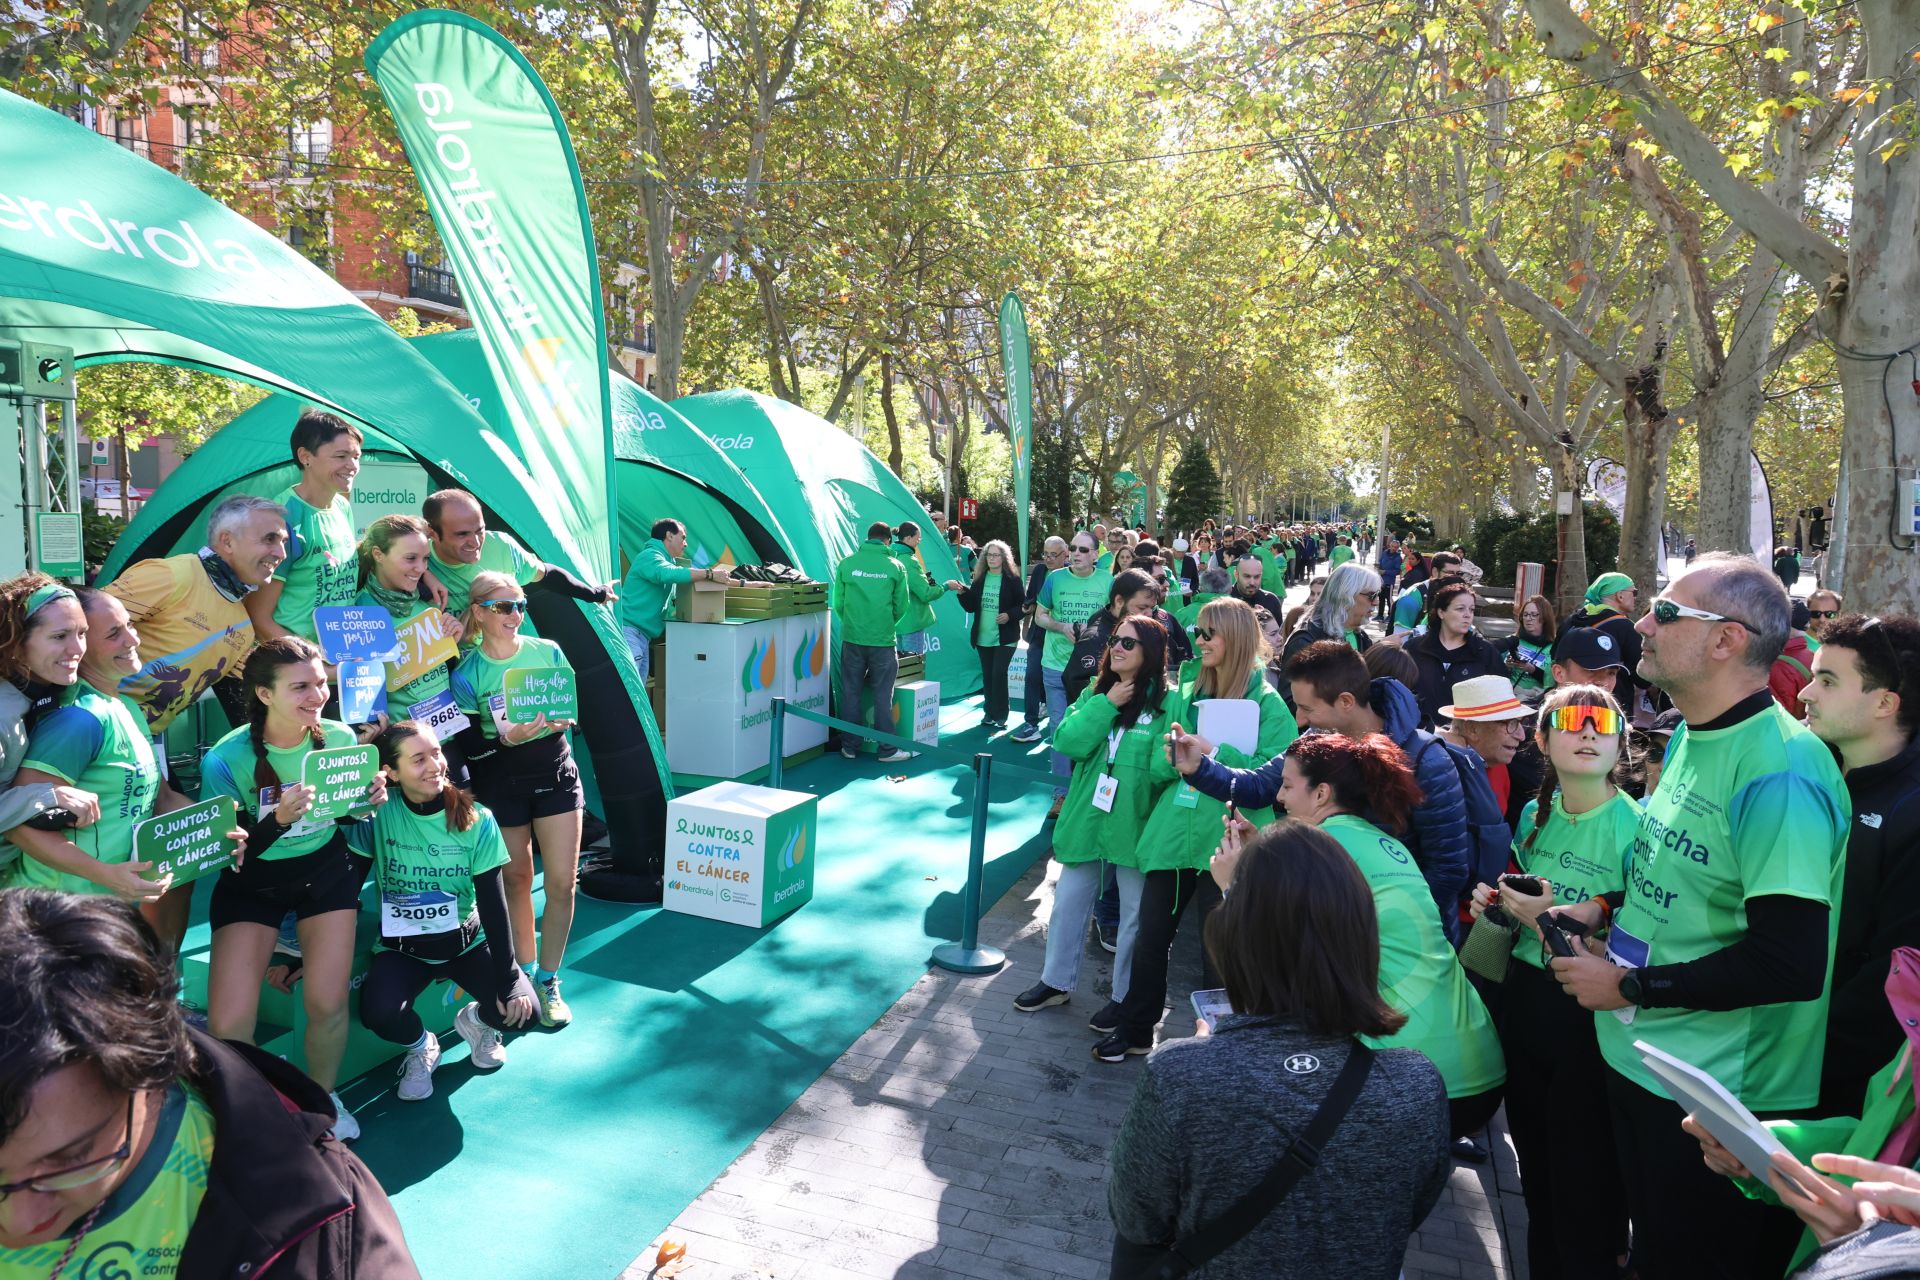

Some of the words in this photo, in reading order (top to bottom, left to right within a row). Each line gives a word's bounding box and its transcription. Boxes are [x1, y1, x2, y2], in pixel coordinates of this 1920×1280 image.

[353, 488, 416, 504] Iberdrola
[1062, 600, 1073, 608] En
[343, 610, 364, 620] HOY
[325, 621, 340, 631] HE
[342, 620, 386, 630] CORRIDO
[512, 694, 549, 707] NUNCA
[327, 754, 360, 769] JUNTOS
[326, 770, 360, 784] CONTRA
[318, 792, 329, 803] EL
[333, 785, 366, 801] CÁNCER
[166, 810, 209, 834] JUNTOS
[166, 826, 211, 851] CONTRA
[690, 822, 740, 842] JUNTOS
[1646, 815, 1709, 866] marcha
[158, 860, 173, 873] EL
[177, 841, 221, 866] CÁNCER
[688, 842, 740, 861] CONTRA
[388, 858, 407, 875] En
[413, 864, 472, 877] marcha
[677, 860, 692, 873] EL
[697, 859, 750, 884] CÁNCER
[387, 877, 440, 891] contra
[682, 882, 714, 897] Iberdrola
[774, 878, 805, 904] Iberdrola
[1548, 880, 1590, 904] arch
[390, 905, 450, 919] 32096
